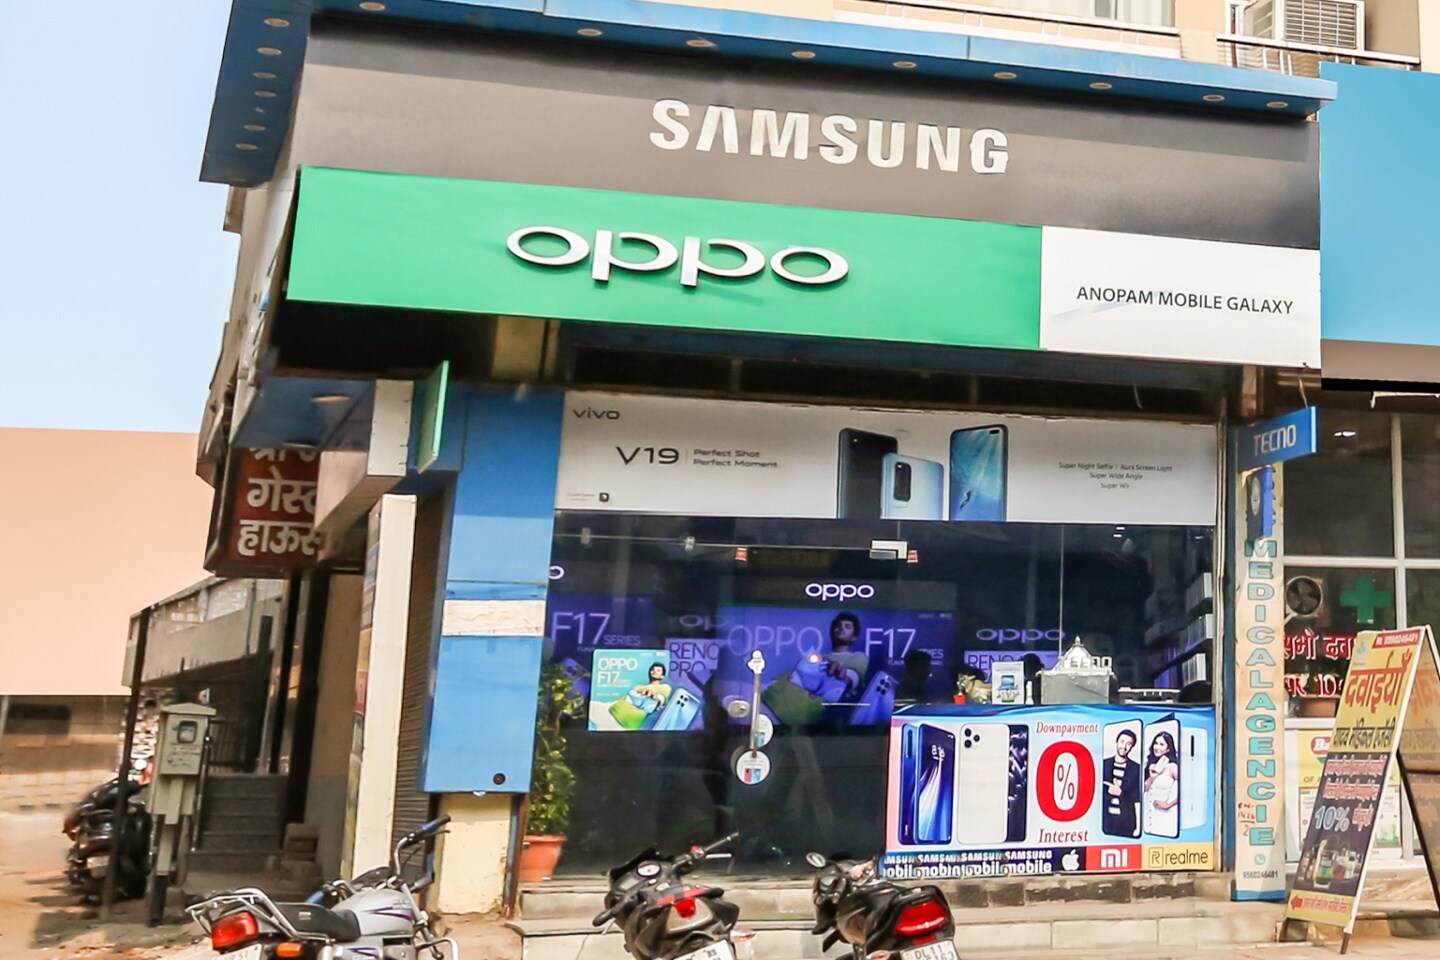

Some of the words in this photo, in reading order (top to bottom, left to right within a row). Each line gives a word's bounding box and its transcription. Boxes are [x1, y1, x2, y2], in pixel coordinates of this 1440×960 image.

[649, 98, 1009, 174] SAMSUNG
[1076, 286, 1154, 305] ANOPAM
[1158, 291, 1222, 310] MOBILE
[1226, 296, 1294, 315] GALAXY
[572, 407, 620, 420] vivo
[1253, 424, 1297, 456] TECNO
[616, 446, 680, 465] V19
[693, 448, 732, 458] Perfect
[734, 449, 760, 458] Shot
[693, 458, 732, 467] Perfect
[734, 459, 778, 468] Moment
[1058, 462, 1077, 470] Super
[551, 611, 611, 645] F17
[603, 635, 641, 646] SERIES
[728, 625, 824, 656] OPPO
[865, 628, 917, 659] F17
[598, 657, 638, 671] OPPO
[597, 671, 621, 684] F17
[1036, 721, 1099, 737] Downpayment
[1314, 806, 1350, 832] 10%
[1038, 828, 1089, 843] Interest
[1005, 850, 1053, 860] SAMSUNG
[1165, 848, 1208, 866] realme
